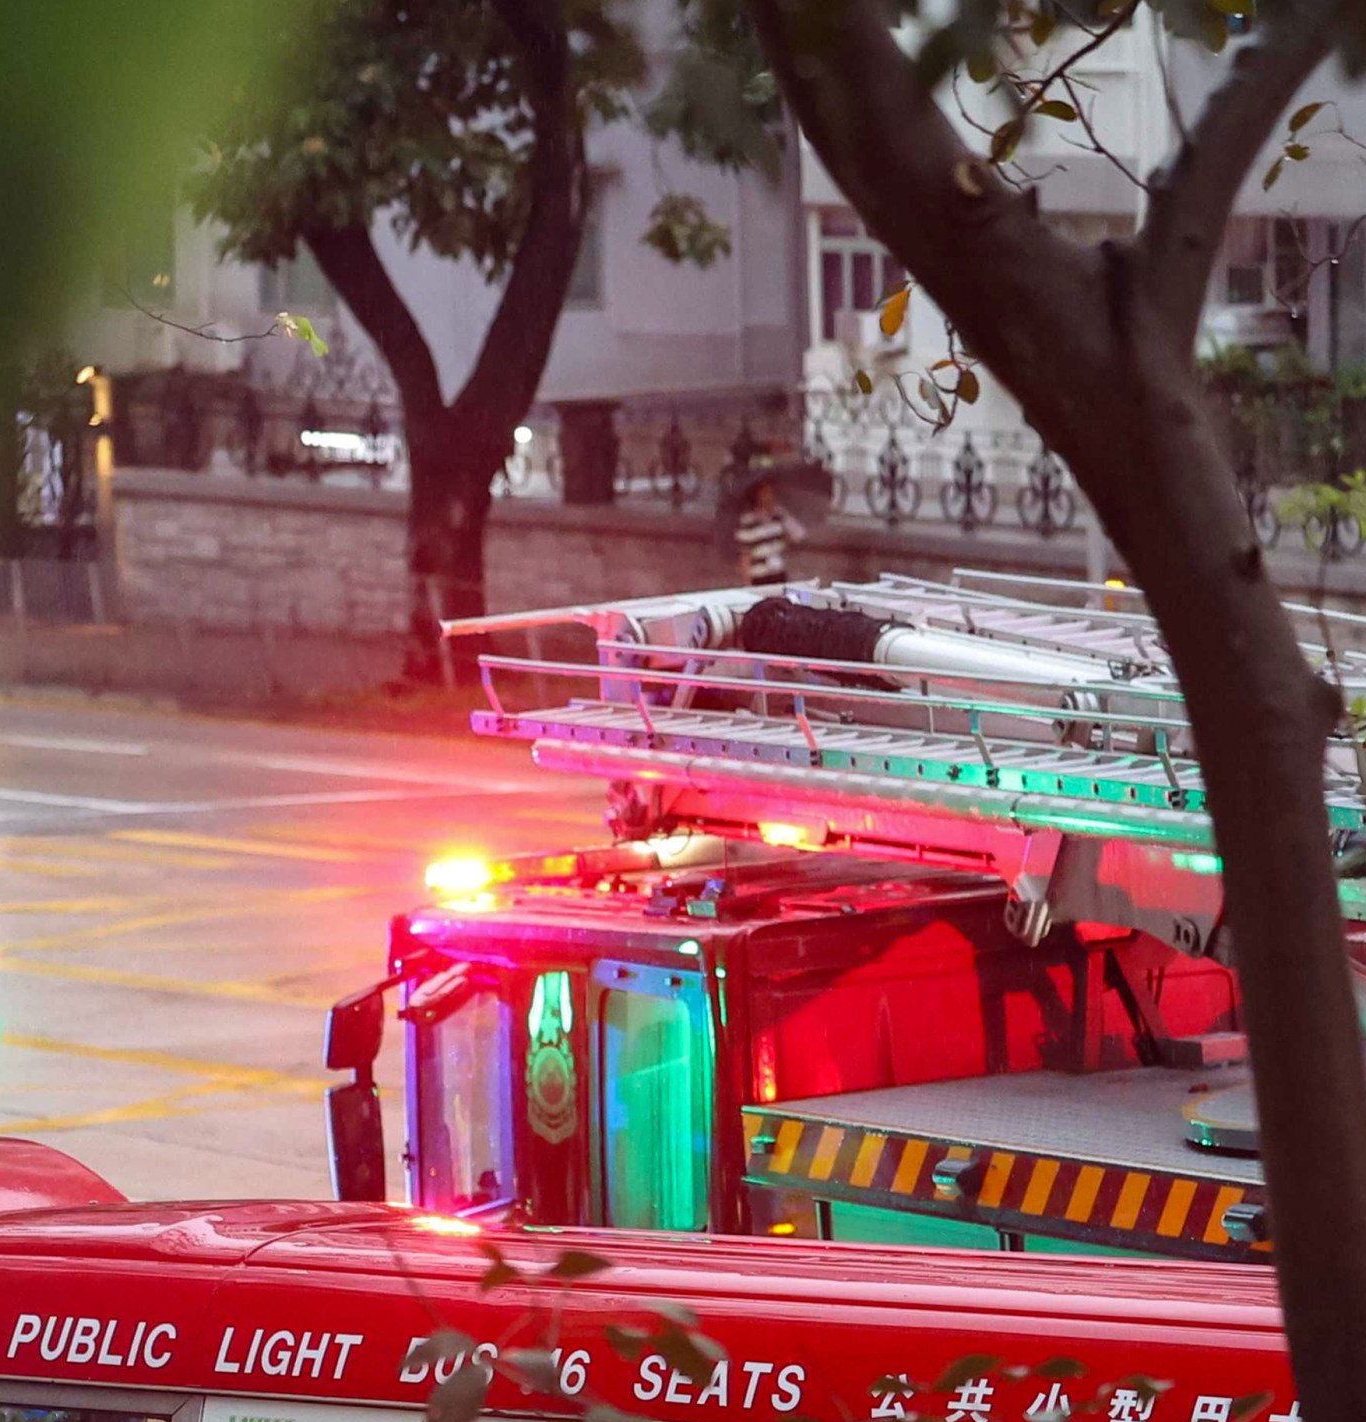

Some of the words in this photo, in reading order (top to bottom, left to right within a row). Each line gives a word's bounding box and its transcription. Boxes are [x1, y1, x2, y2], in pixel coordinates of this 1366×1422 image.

[7, 1314, 177, 1369] PUBLIC
[214, 1327, 363, 1380] LIGHT
[634, 1353, 807, 1412] SEATS
